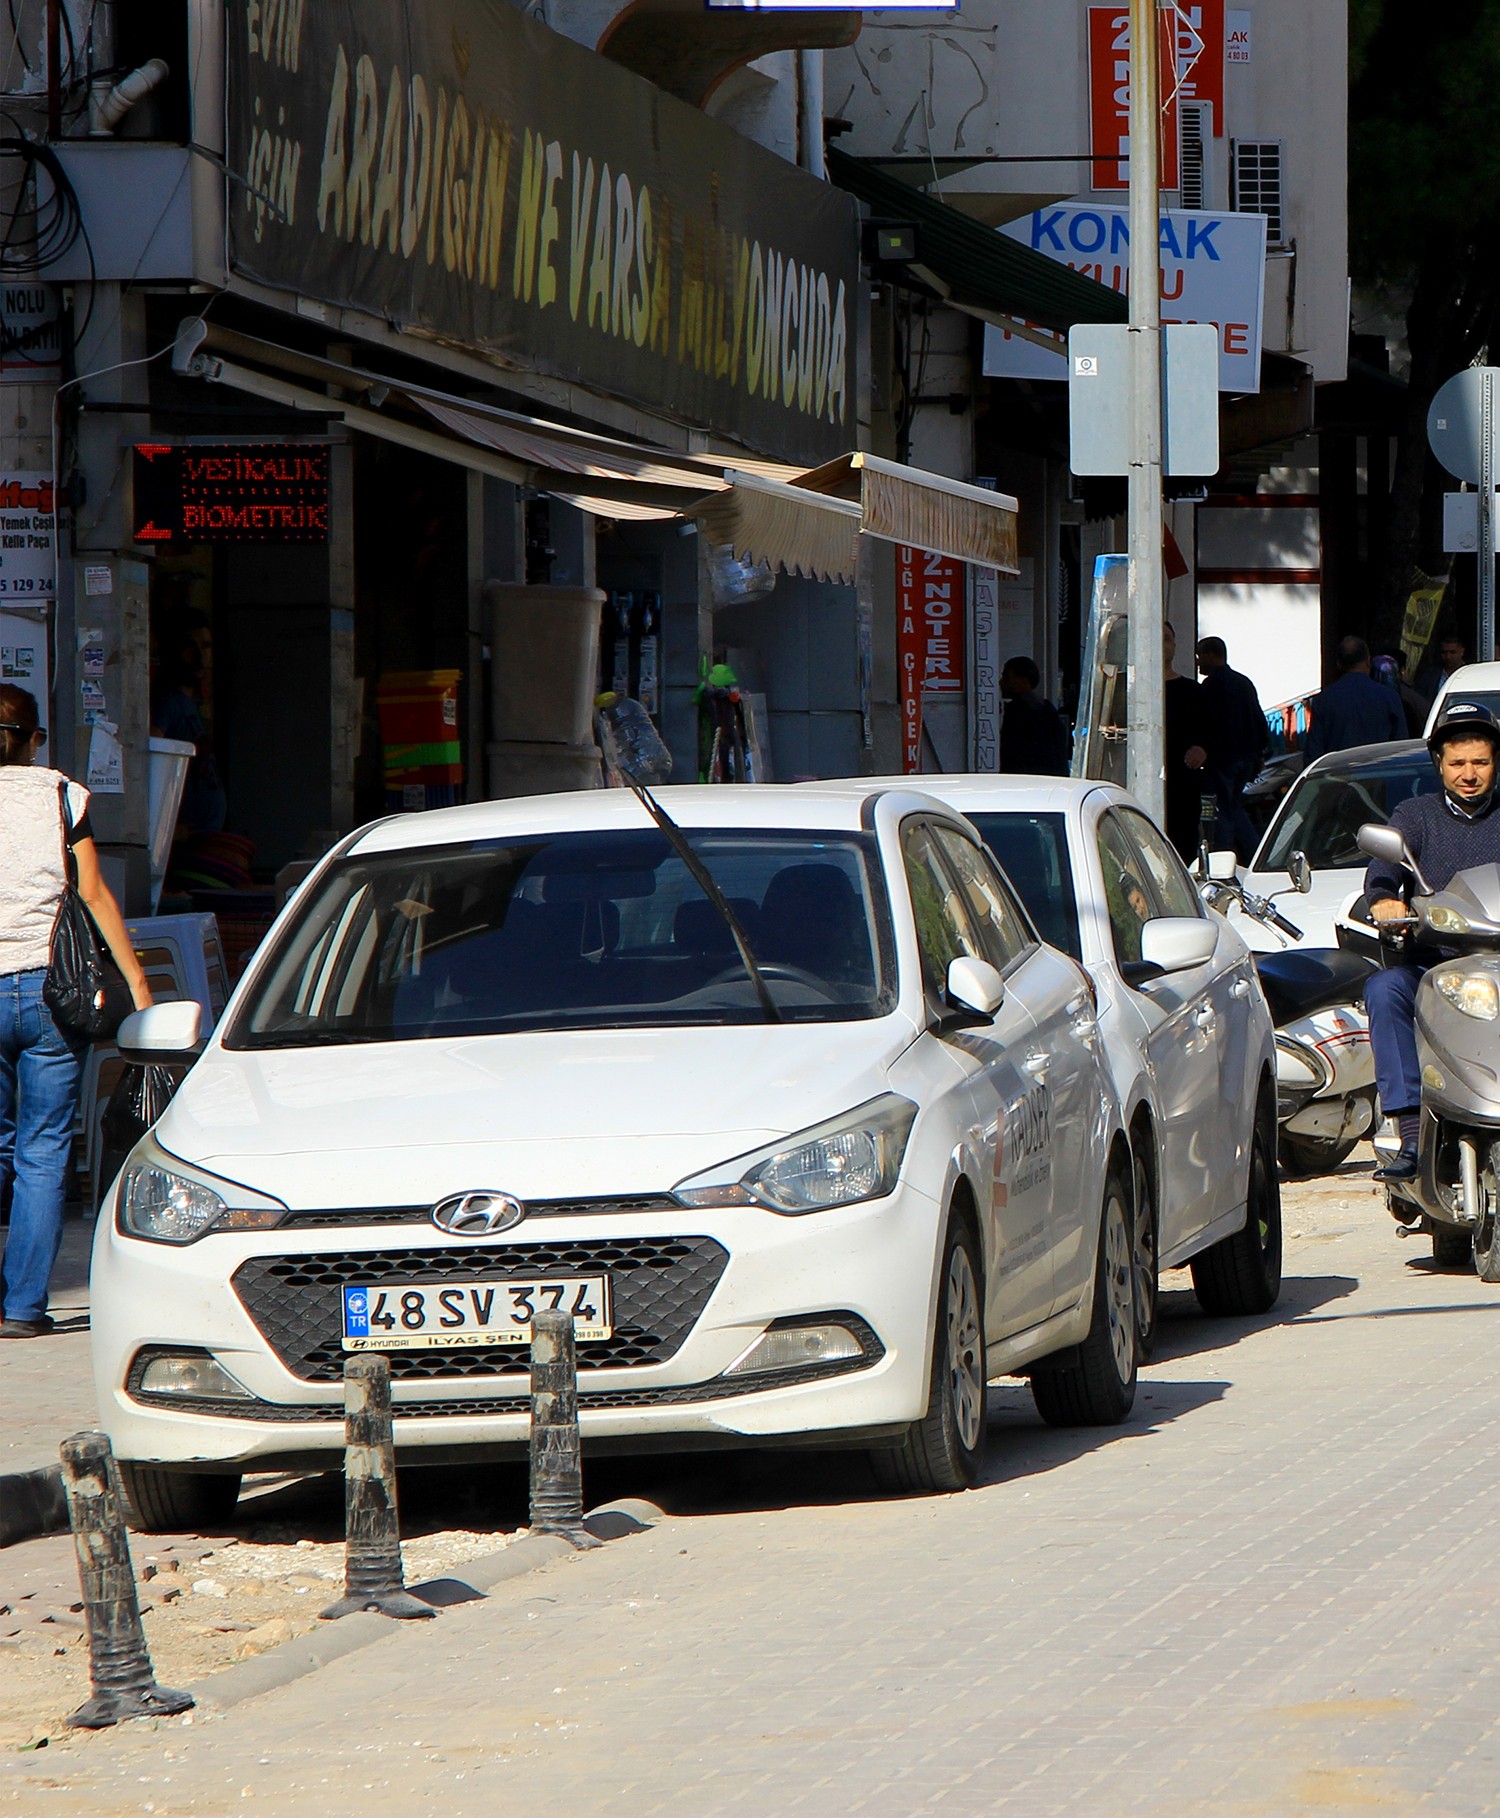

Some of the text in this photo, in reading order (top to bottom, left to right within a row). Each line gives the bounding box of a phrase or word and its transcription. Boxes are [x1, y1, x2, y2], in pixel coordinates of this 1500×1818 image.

[512, 127, 562, 309] NE
[569, 149, 670, 357] VARSA
[6, 289, 45, 314] NOLU
[186, 452, 321, 480] VESİKALIK
[1, 516, 31, 530] Yemek
[183, 499, 326, 528] BİOMETRİK
[2, 534, 50, 550] Kelle Paça
[13, 578, 34, 592] 129
[38, 578, 54, 591] 24
[923, 582, 952, 674] NOTER
[903, 652, 920, 775] ÇİÇEK
[370, 1284, 597, 1330] 48 SV 374
[350, 1315, 367, 1328] TR
[370, 1338, 410, 1348] HYUNDAI
[428, 1334, 479, 1346] İLYAS
[486, 1333, 523, 1345] ŞEN
